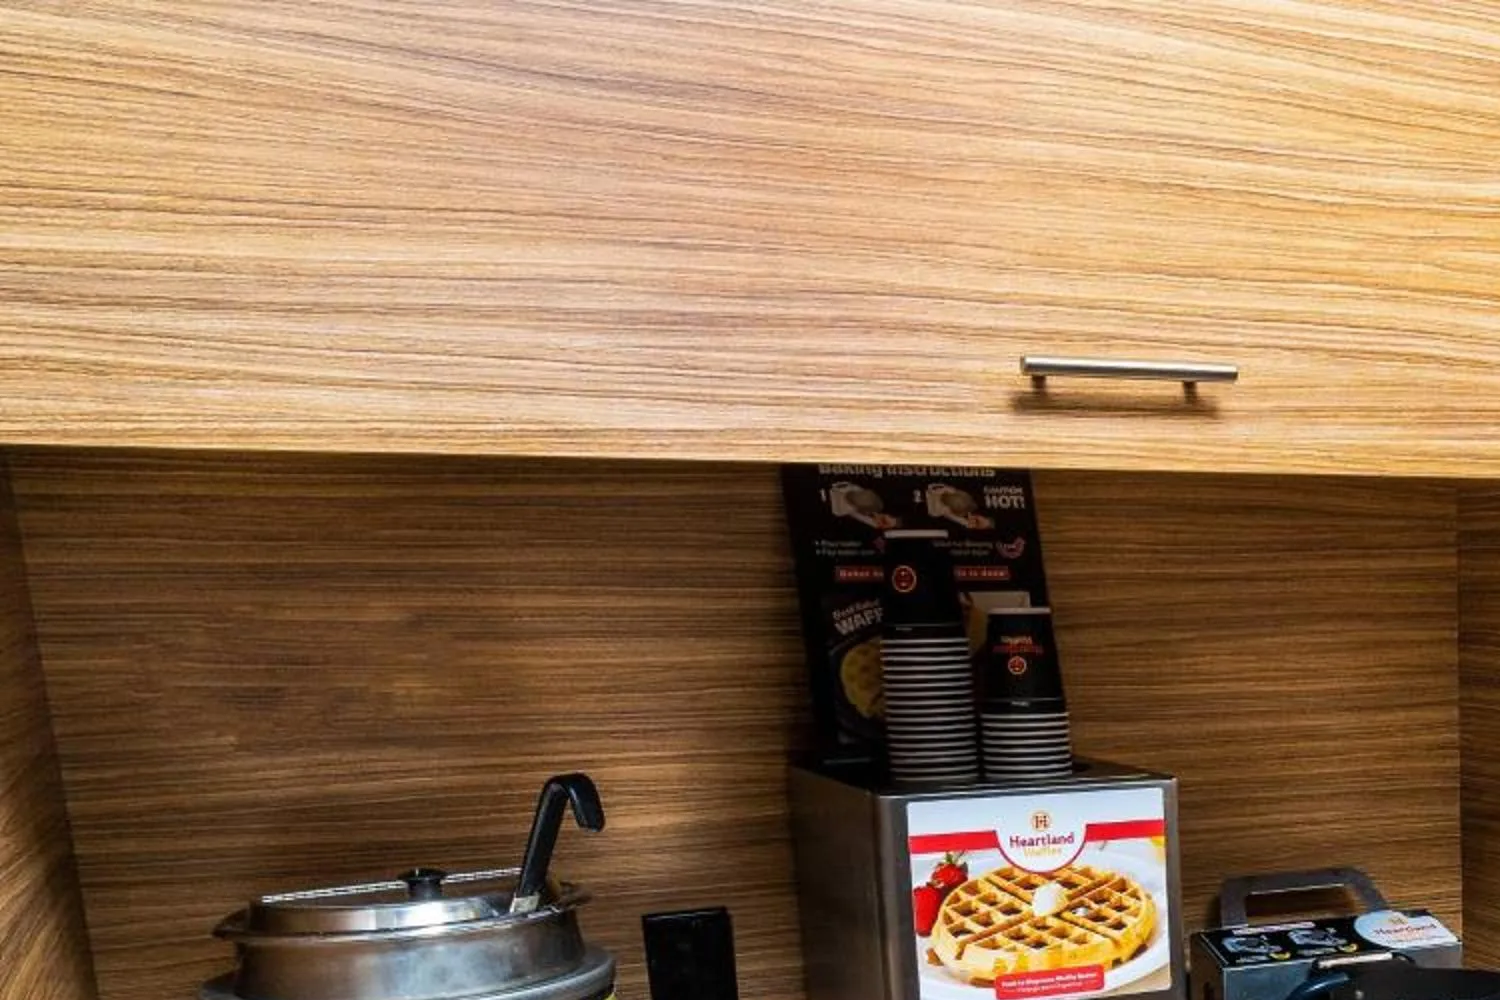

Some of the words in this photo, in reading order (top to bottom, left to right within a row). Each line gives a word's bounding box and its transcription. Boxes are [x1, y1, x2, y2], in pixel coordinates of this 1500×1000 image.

[834, 607, 884, 635] WAFF
[1009, 832, 1075, 849] Heartland
[1373, 923, 1437, 935] Heartland
